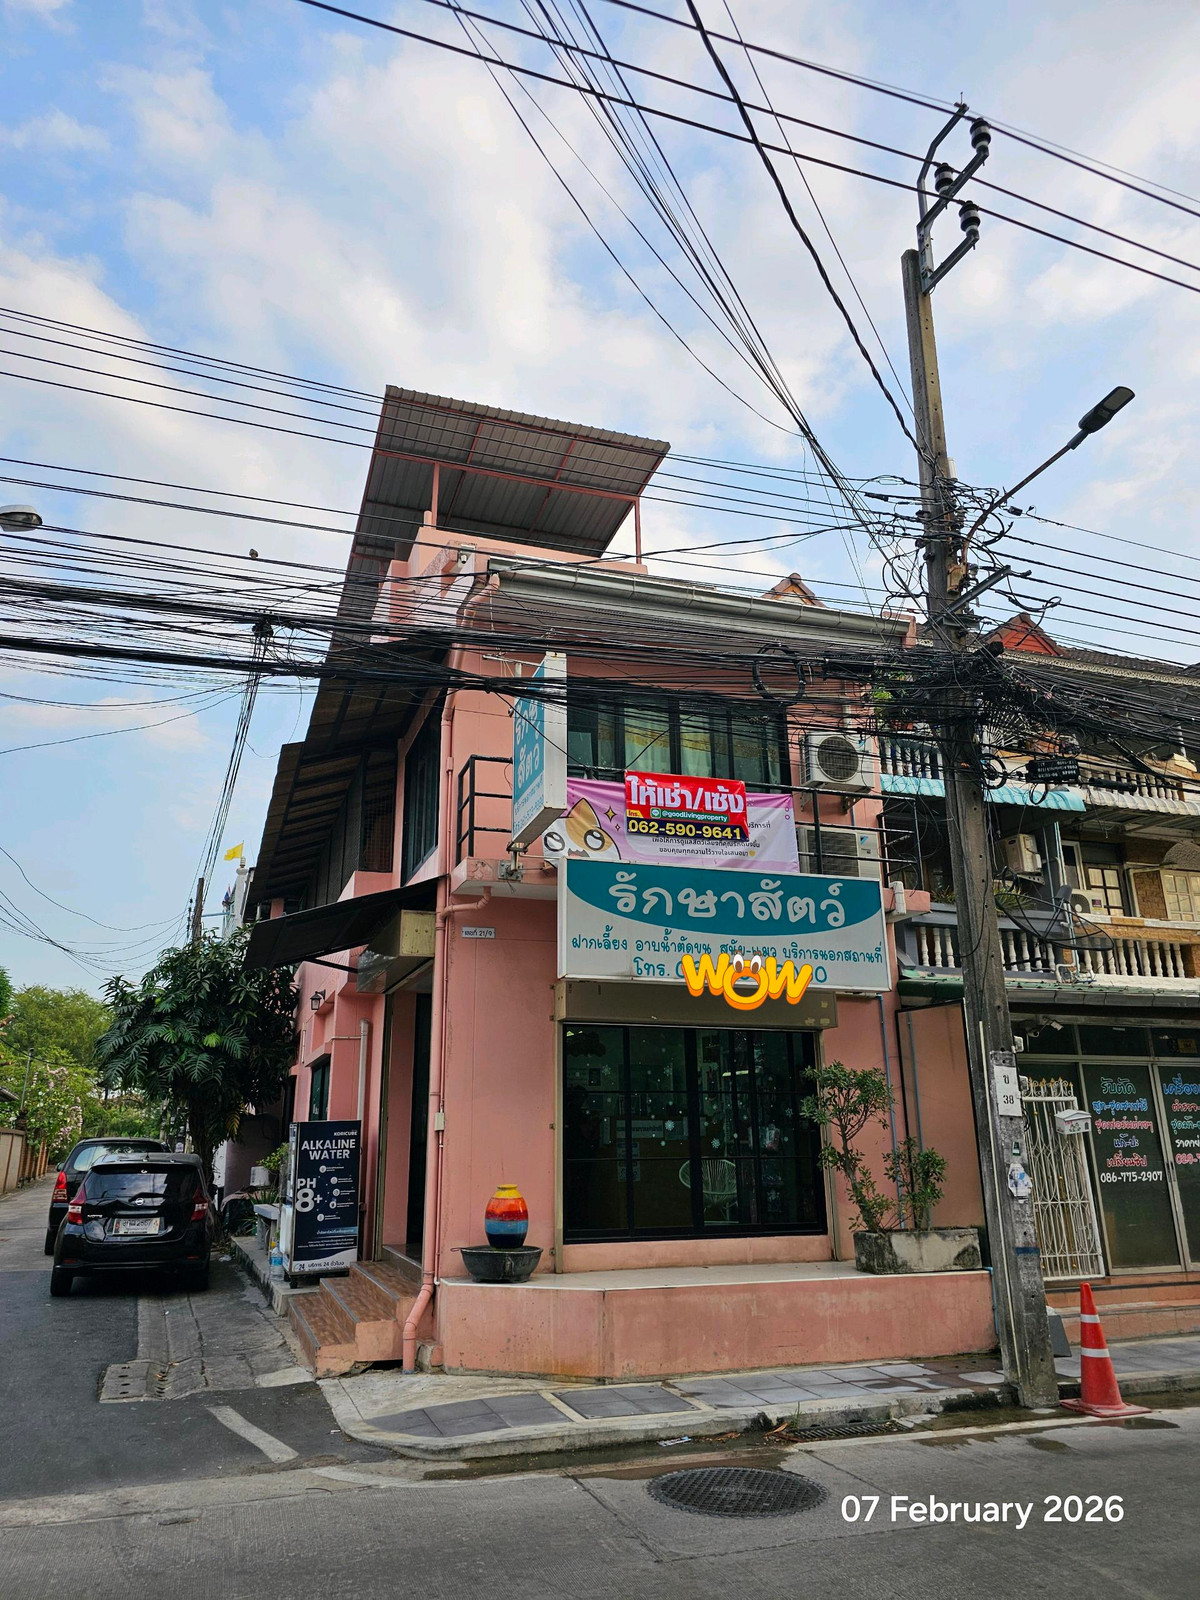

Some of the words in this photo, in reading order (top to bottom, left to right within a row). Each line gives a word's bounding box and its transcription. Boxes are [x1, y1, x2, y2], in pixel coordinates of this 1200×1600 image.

[626, 774, 746, 814] ให้เช่า/เซ้ง
[628, 819, 742, 840] 062-590-9641
[608, 870, 847, 928] รักษาสัตว์
[571, 924, 629, 951] ฝากเลี้ยง
[635, 928, 713, 955] อาบน้ำตัดขน
[782, 941, 884, 965] บริการนอกสถานที่
[633, 956, 670, 979] โทร.
[1100, 1076, 1137, 1095] รับตัด
[1162, 1073, 1200, 1096] เครื่อง
[1002, 1094, 1015, 1105] 38
[301, 1138, 356, 1151] ALKALINE
[309, 1149, 351, 1161] WATER
[297, 1177, 317, 1190] PH
[1100, 1170, 1163, 1184] 086-775-2907
[295, 1188, 323, 1213] 8+
